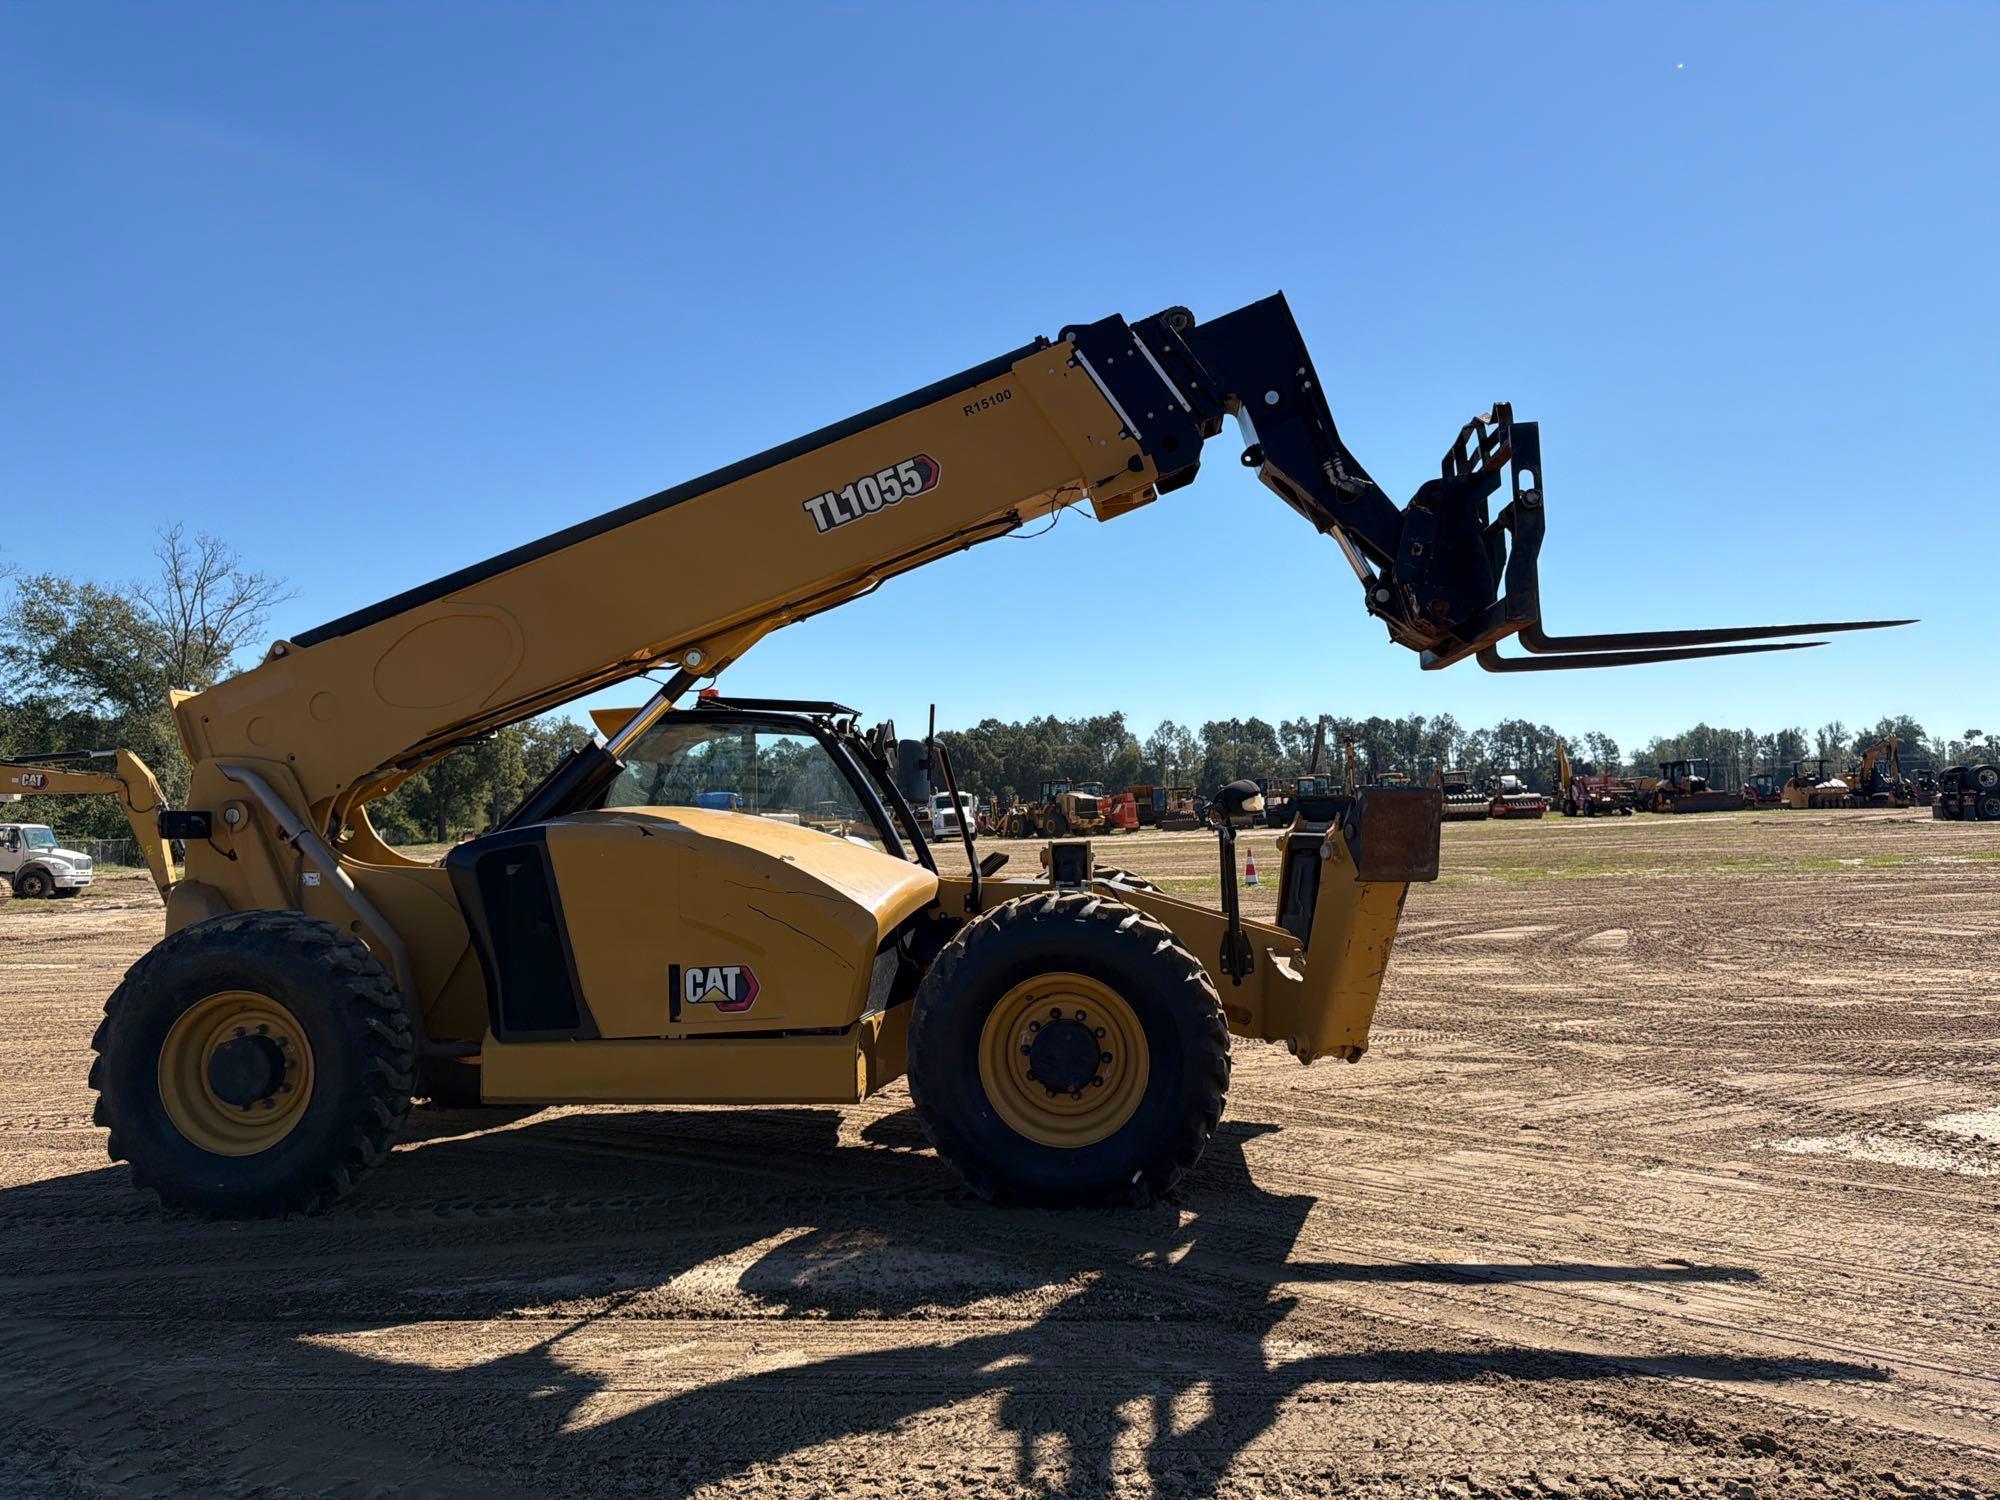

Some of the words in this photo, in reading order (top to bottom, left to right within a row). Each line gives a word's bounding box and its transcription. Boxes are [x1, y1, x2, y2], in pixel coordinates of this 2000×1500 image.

[963, 389, 1012, 417] R15100
[803, 459, 923, 532] TL1055
[21, 773, 43, 787] CAT
[685, 966, 741, 1003] CAT
